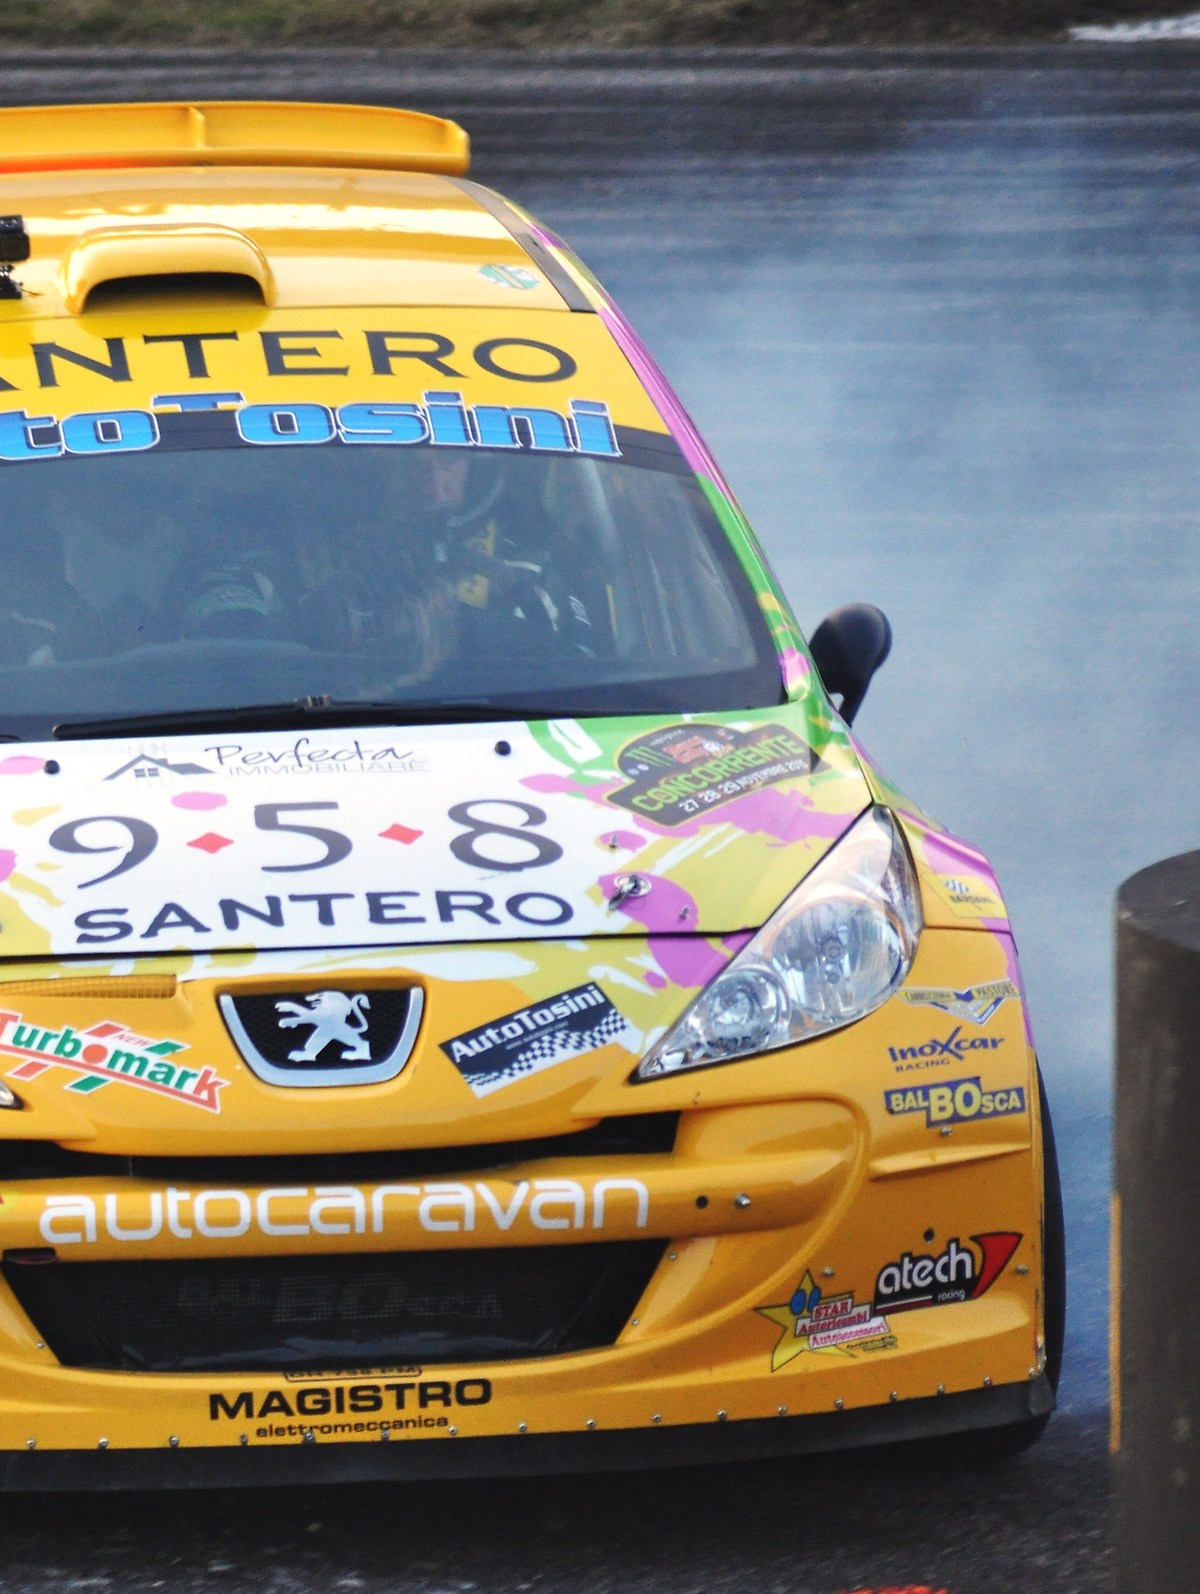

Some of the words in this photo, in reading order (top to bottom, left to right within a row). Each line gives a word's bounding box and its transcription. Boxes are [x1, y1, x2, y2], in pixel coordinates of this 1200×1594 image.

[203, 737, 414, 768] Perfecta
[227, 760, 432, 776] IMMOBILIARE
[631, 733, 806, 812] CONCORRENTE
[48, 815, 159, 890] 9
[253, 801, 354, 873] 5
[447, 799, 564, 872] 8
[75, 890, 575, 944] SANTERO
[450, 984, 607, 1063] AutoTosini
[114, 1033, 155, 1047] NEW
[895, 1059, 951, 1073] RACING
[38, 1178, 650, 1245] autocaravan
[878, 1242, 976, 1295] atech
[936, 1289, 966, 1301] racing
[799, 1311, 868, 1335] Autoricambi
[814, 1301, 849, 1318] STAR
[811, 1322, 887, 1346] Autoaccessori
[208, 1377, 493, 1421] MAGISTRO
[256, 1414, 450, 1438] elettromeccanica
